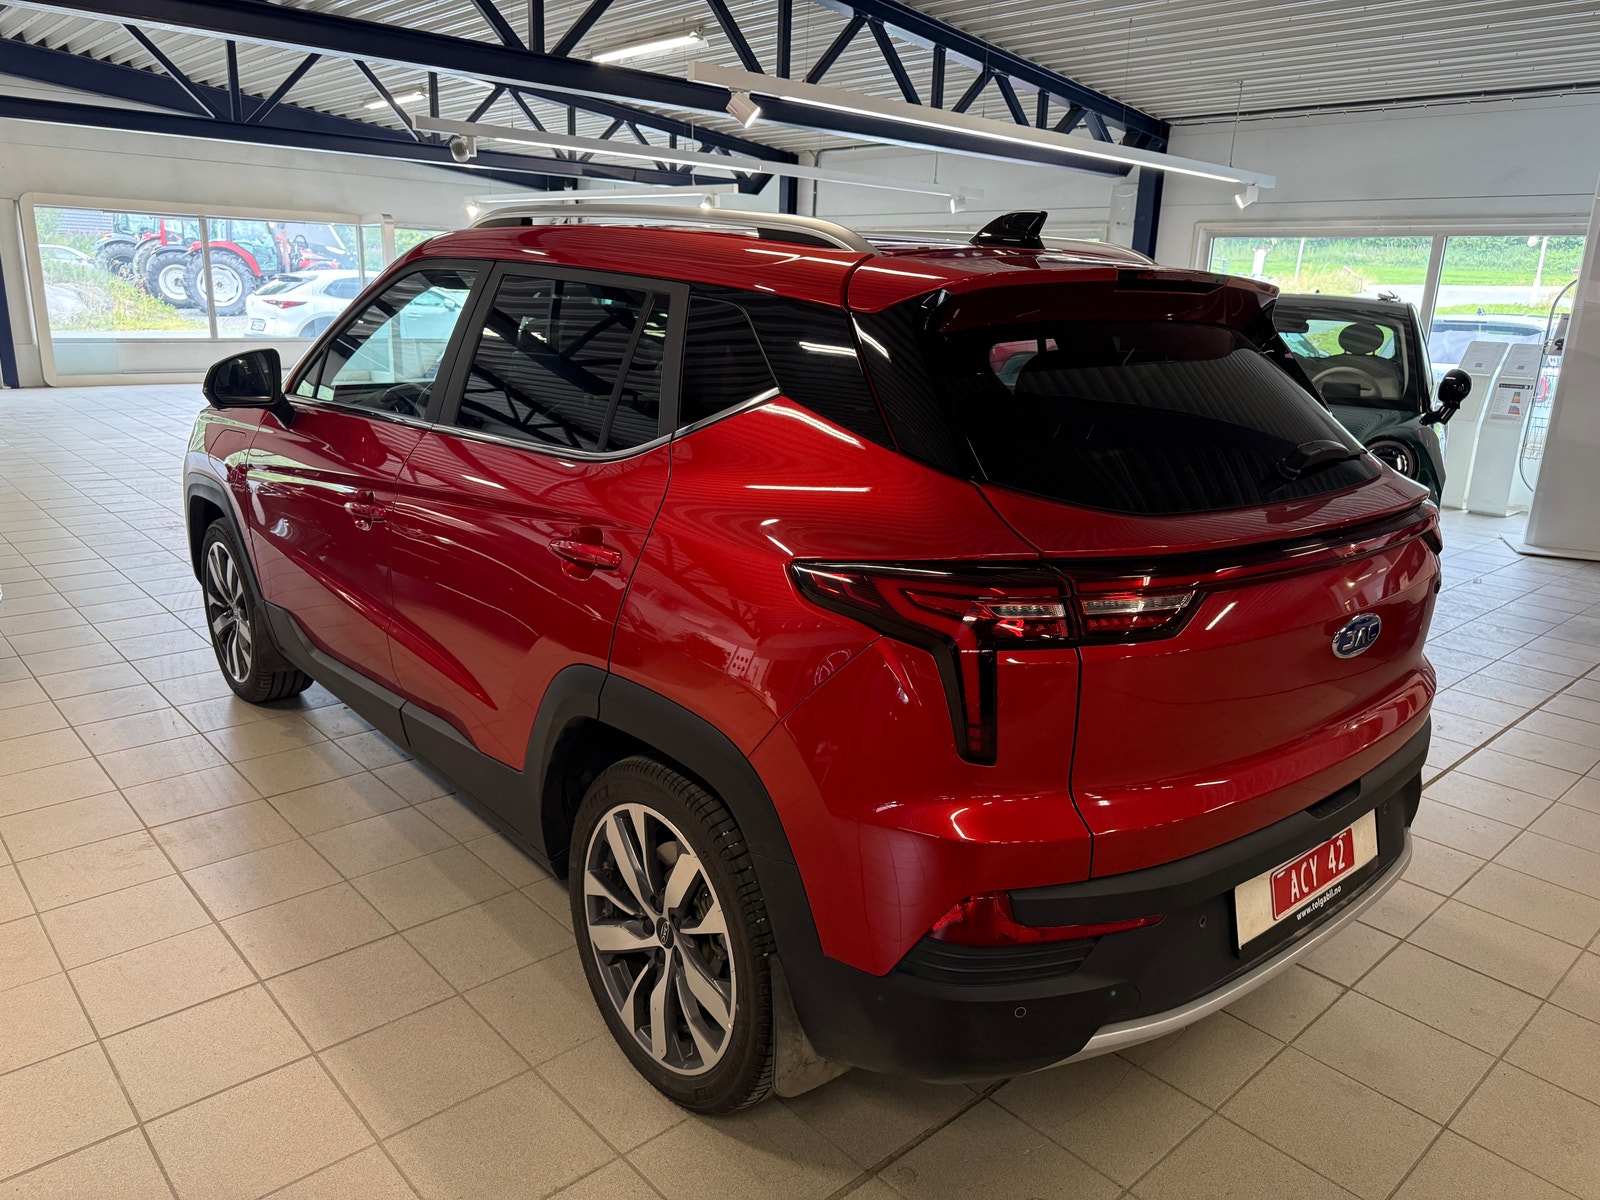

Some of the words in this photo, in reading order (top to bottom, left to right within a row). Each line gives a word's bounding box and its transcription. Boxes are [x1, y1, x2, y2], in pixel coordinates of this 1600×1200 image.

[1342, 621, 1378, 651] JAC
[1291, 854, 1317, 902] ACY
[1328, 839, 1345, 873] 42
[1296, 885, 1341, 921] www.tolgabil.no
